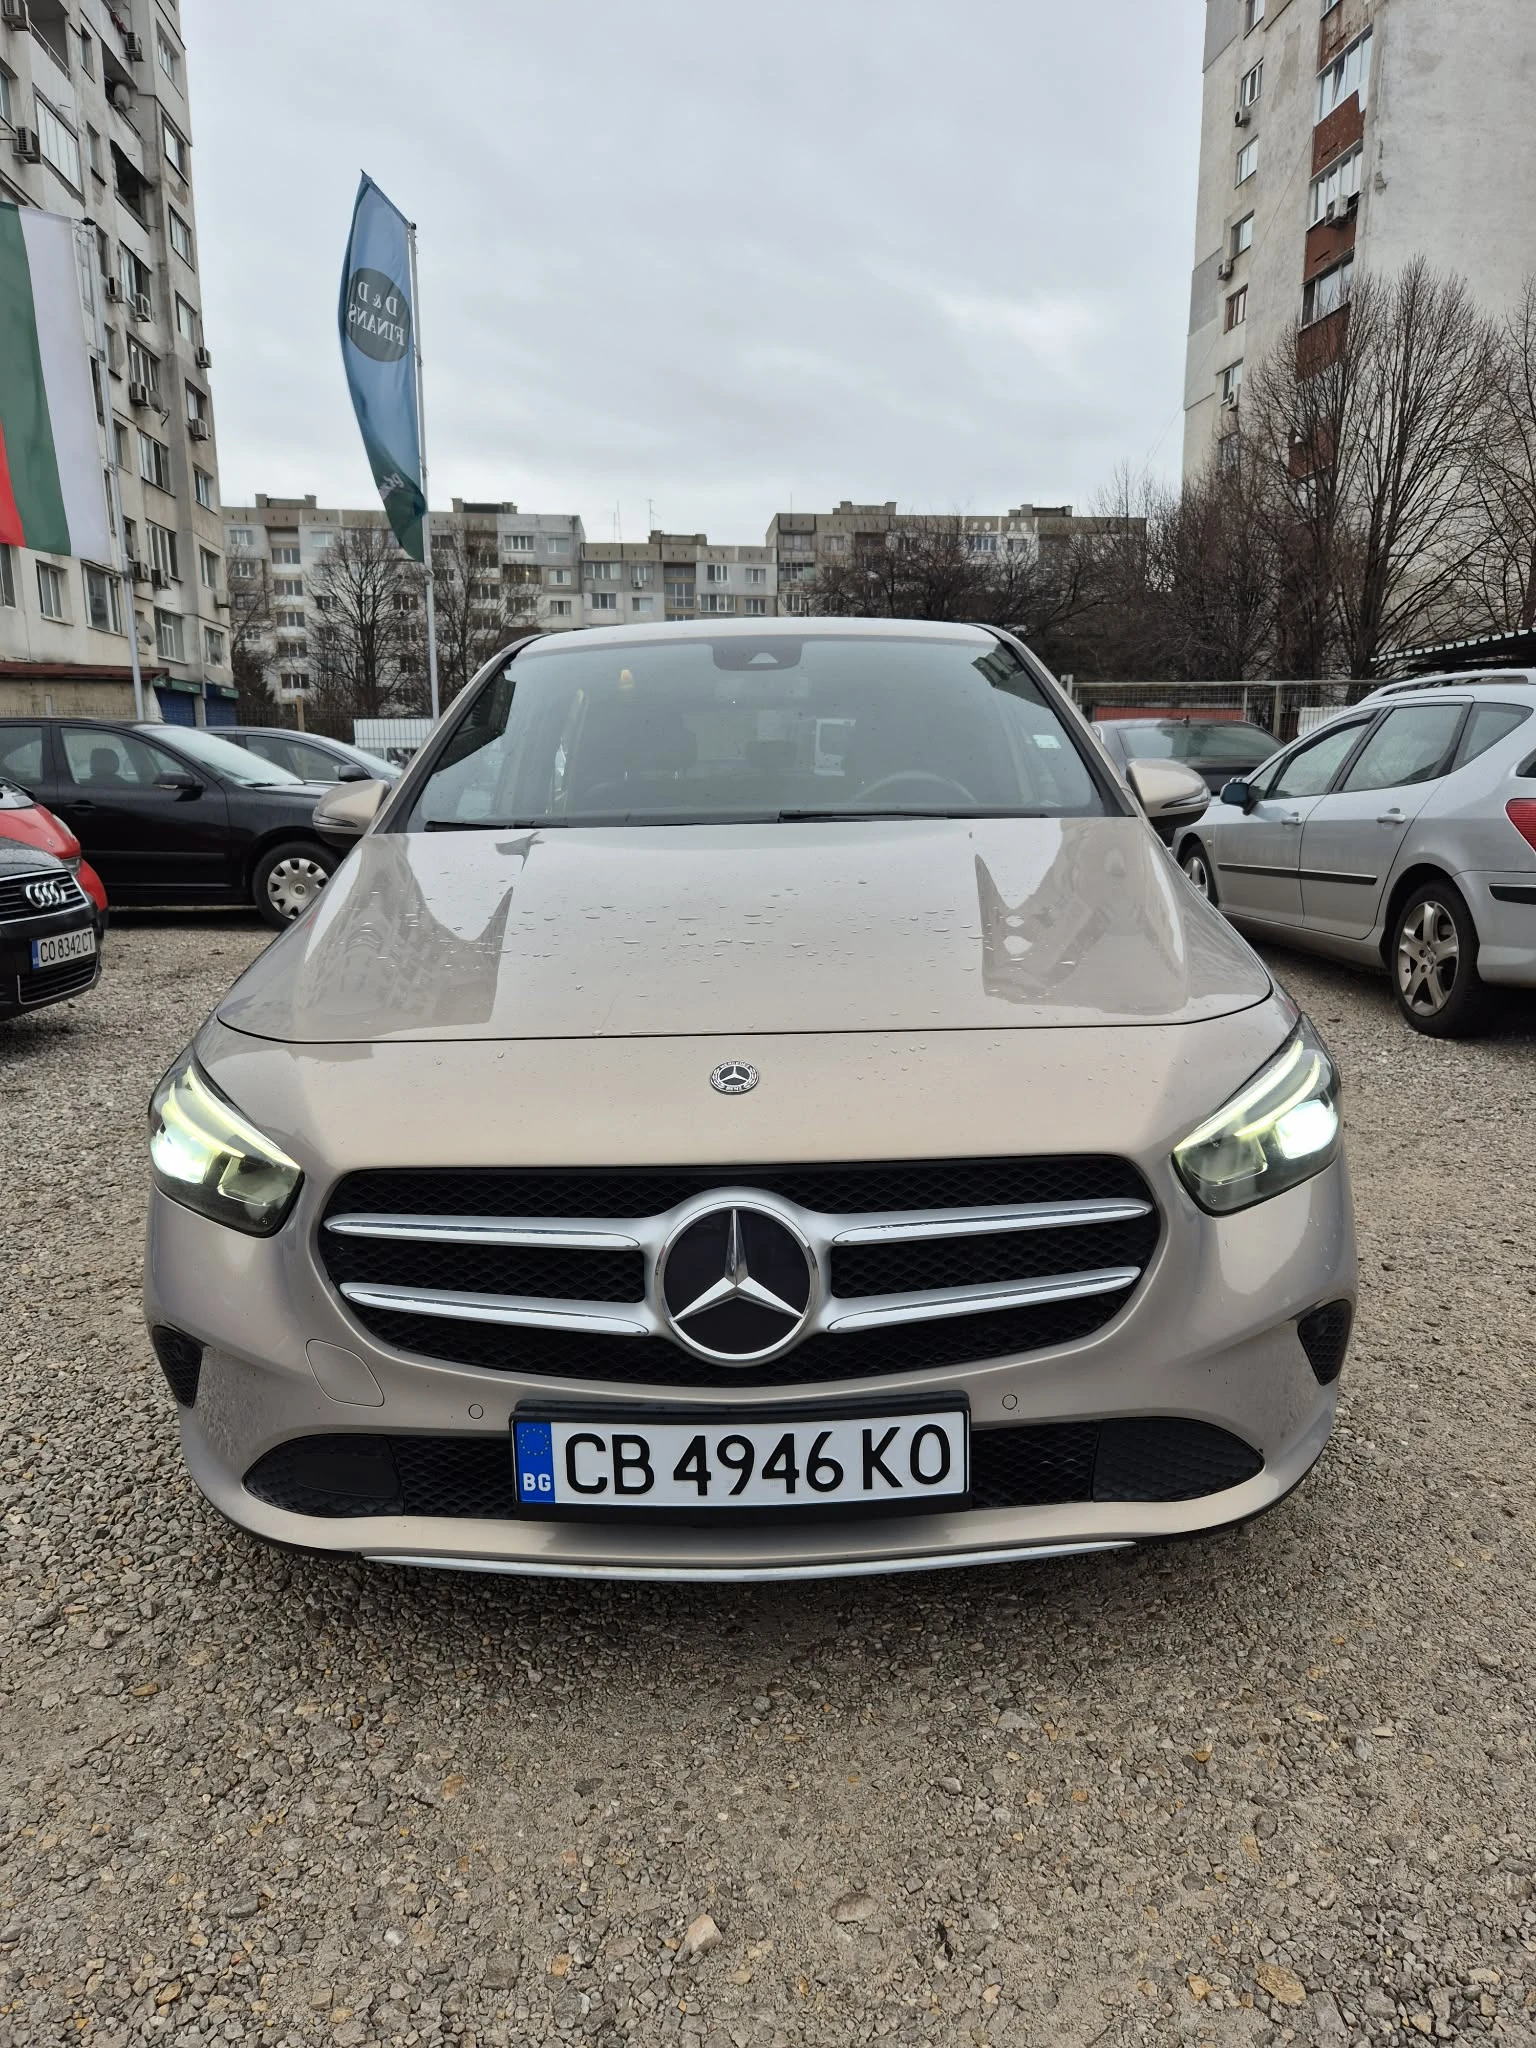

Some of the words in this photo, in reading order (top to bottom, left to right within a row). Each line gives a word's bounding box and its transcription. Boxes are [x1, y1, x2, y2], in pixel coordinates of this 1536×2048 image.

[58, 935, 81, 958] 8342
[81, 931, 93, 952] CT
[565, 1432, 655, 1494] CB
[673, 1431, 844, 1496] 4946
[862, 1423, 951, 1490] KO
[523, 1472, 551, 1492] BG
